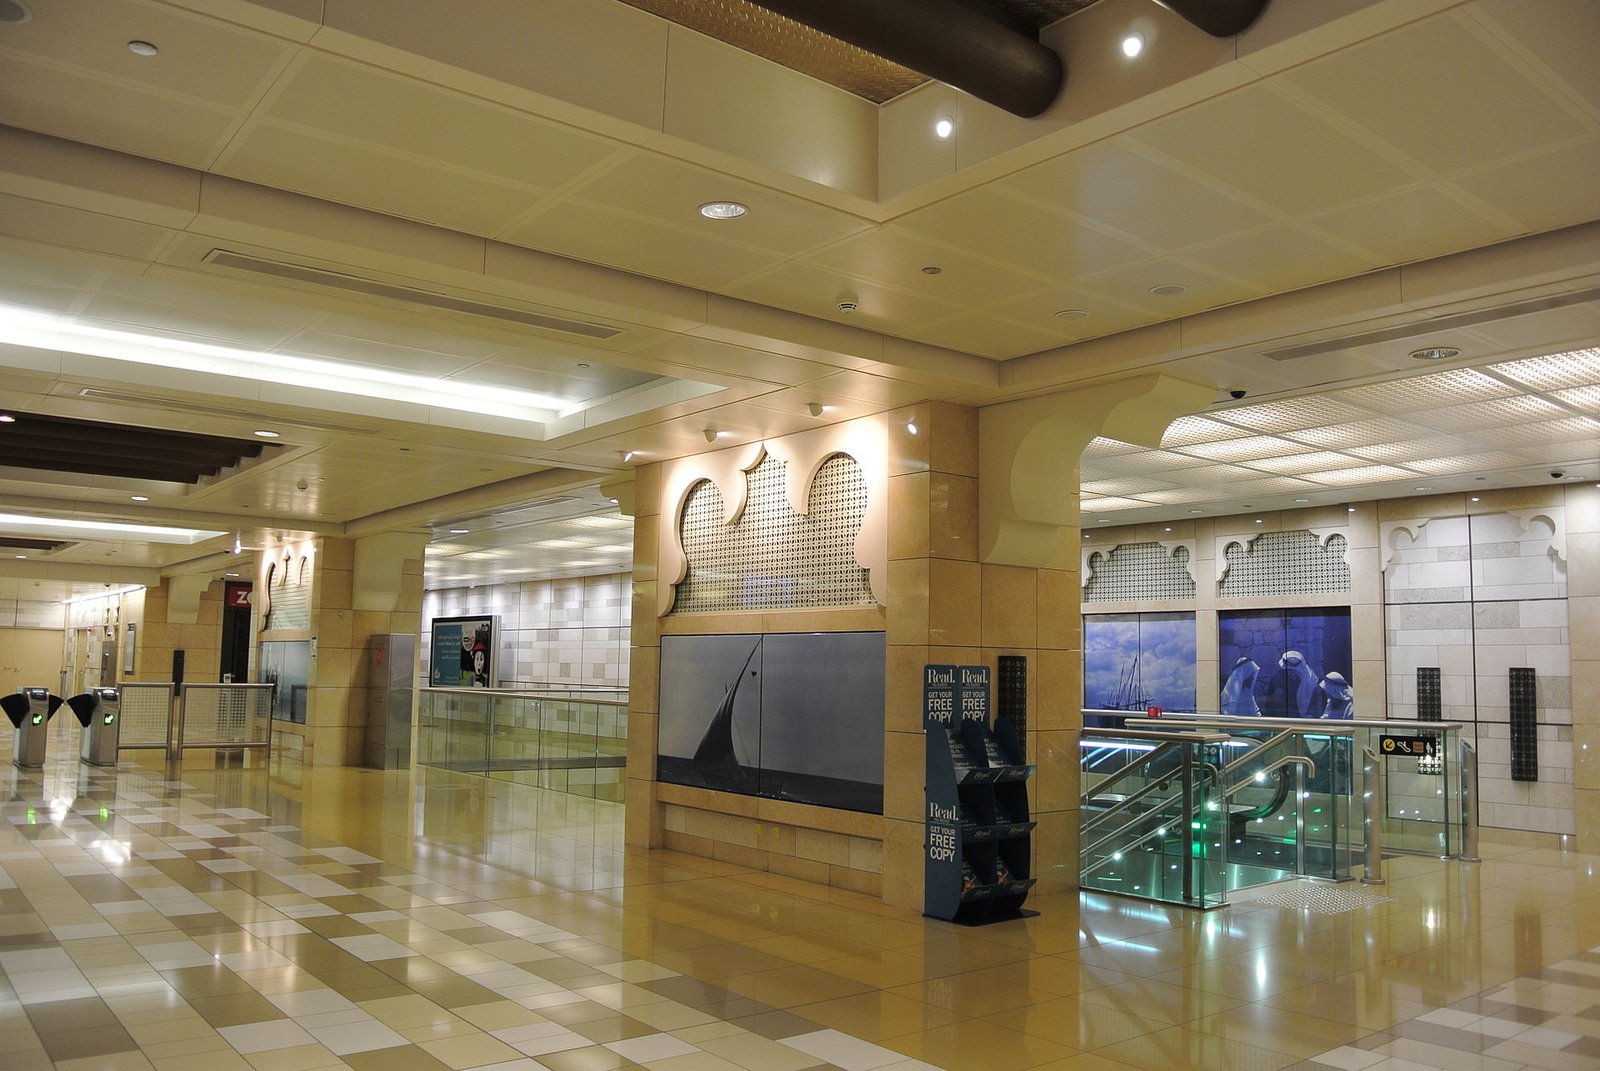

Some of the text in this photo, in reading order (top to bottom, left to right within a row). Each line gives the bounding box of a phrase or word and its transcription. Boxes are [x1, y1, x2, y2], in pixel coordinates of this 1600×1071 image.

[928, 669, 956, 684] Read.
[962, 669, 989, 684] Read.
[928, 698, 953, 711] FREE
[962, 698, 986, 710] FREE
[928, 711, 953, 723] COPY
[962, 710, 986, 722] COPY
[930, 802, 959, 821] Read.
[930, 825, 956, 836] GET YOUR
[930, 833, 956, 850] FREE
[930, 846, 956, 862] COPY
